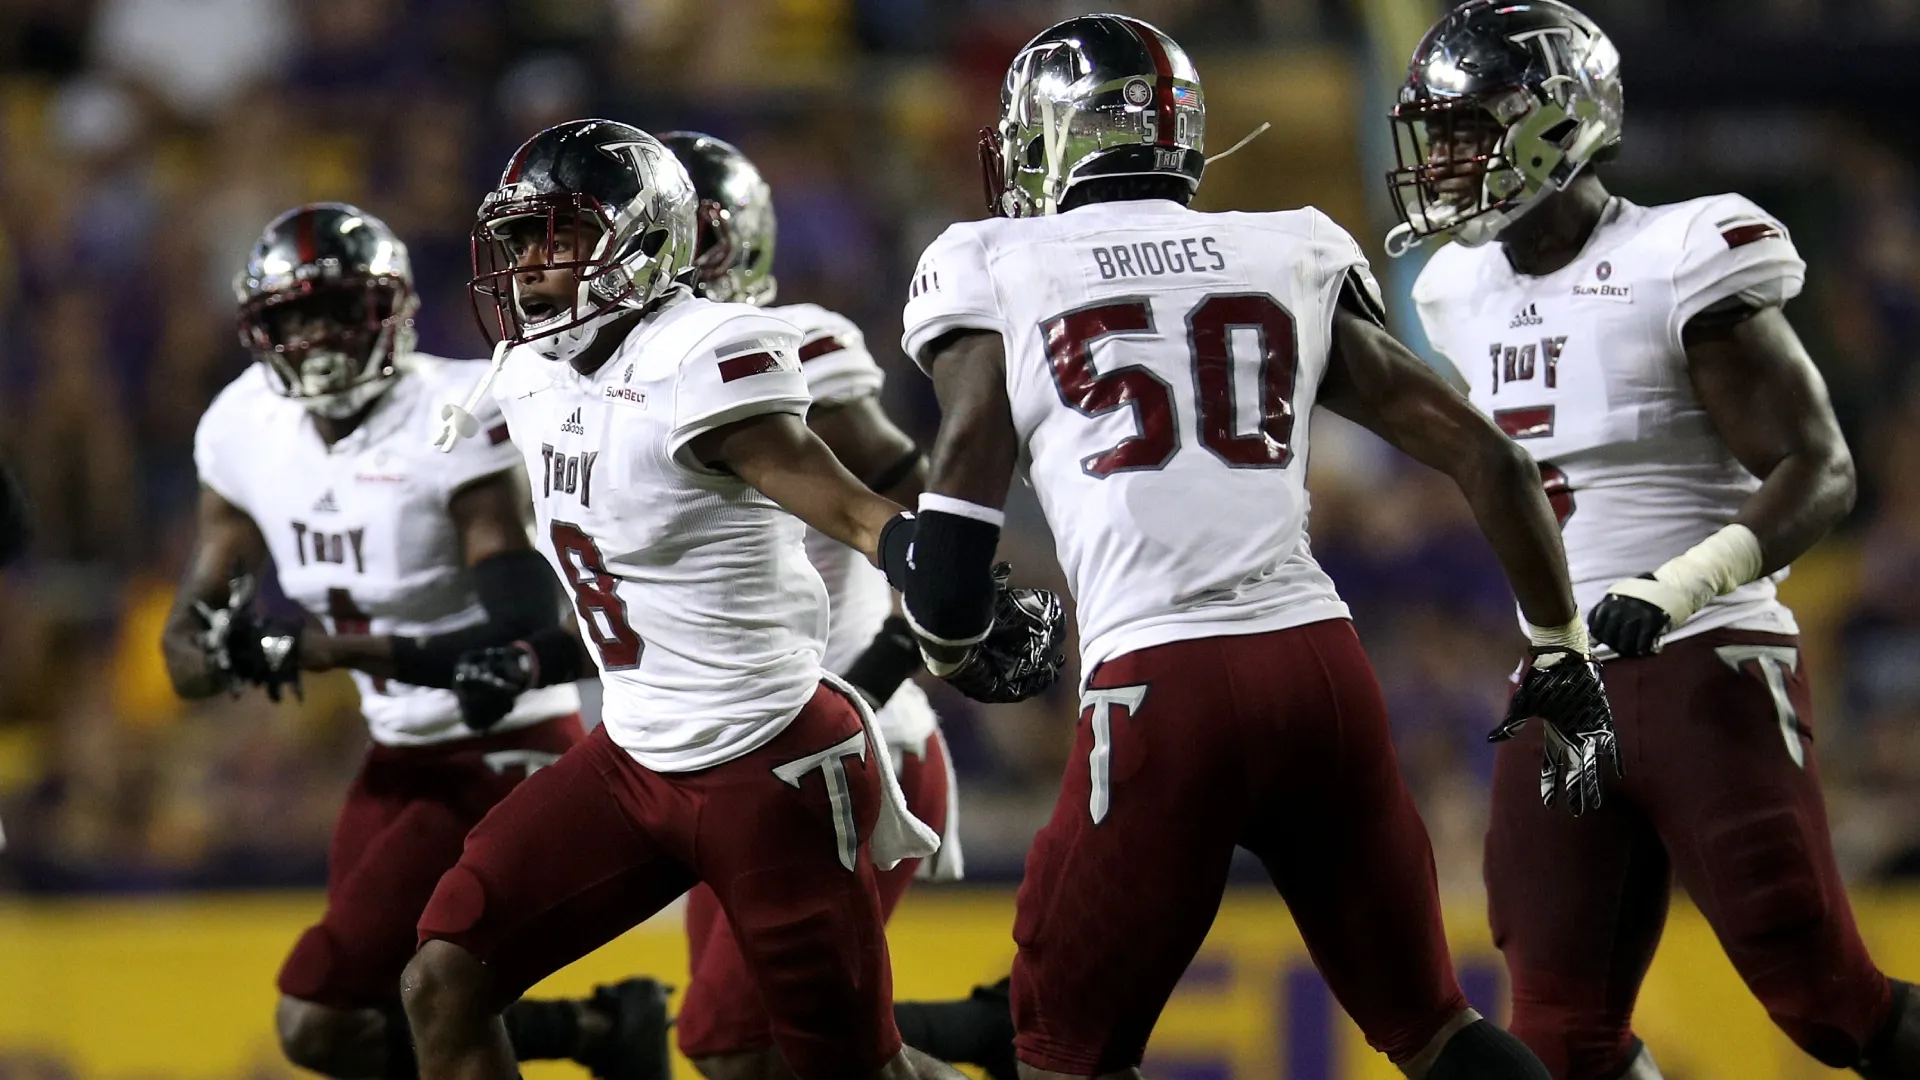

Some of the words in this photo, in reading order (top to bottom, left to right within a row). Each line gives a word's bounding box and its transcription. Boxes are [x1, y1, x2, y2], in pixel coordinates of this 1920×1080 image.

[1154, 147, 1187, 171] TROY
[1093, 236, 1225, 280] BRIDGES
[1039, 291, 1299, 479] 50
[1489, 335, 1568, 395] TROY
[560, 423, 585, 436] adidas
[541, 442, 599, 509] TROY
[290, 520, 365, 574] TROY
[550, 518, 646, 672] 8
